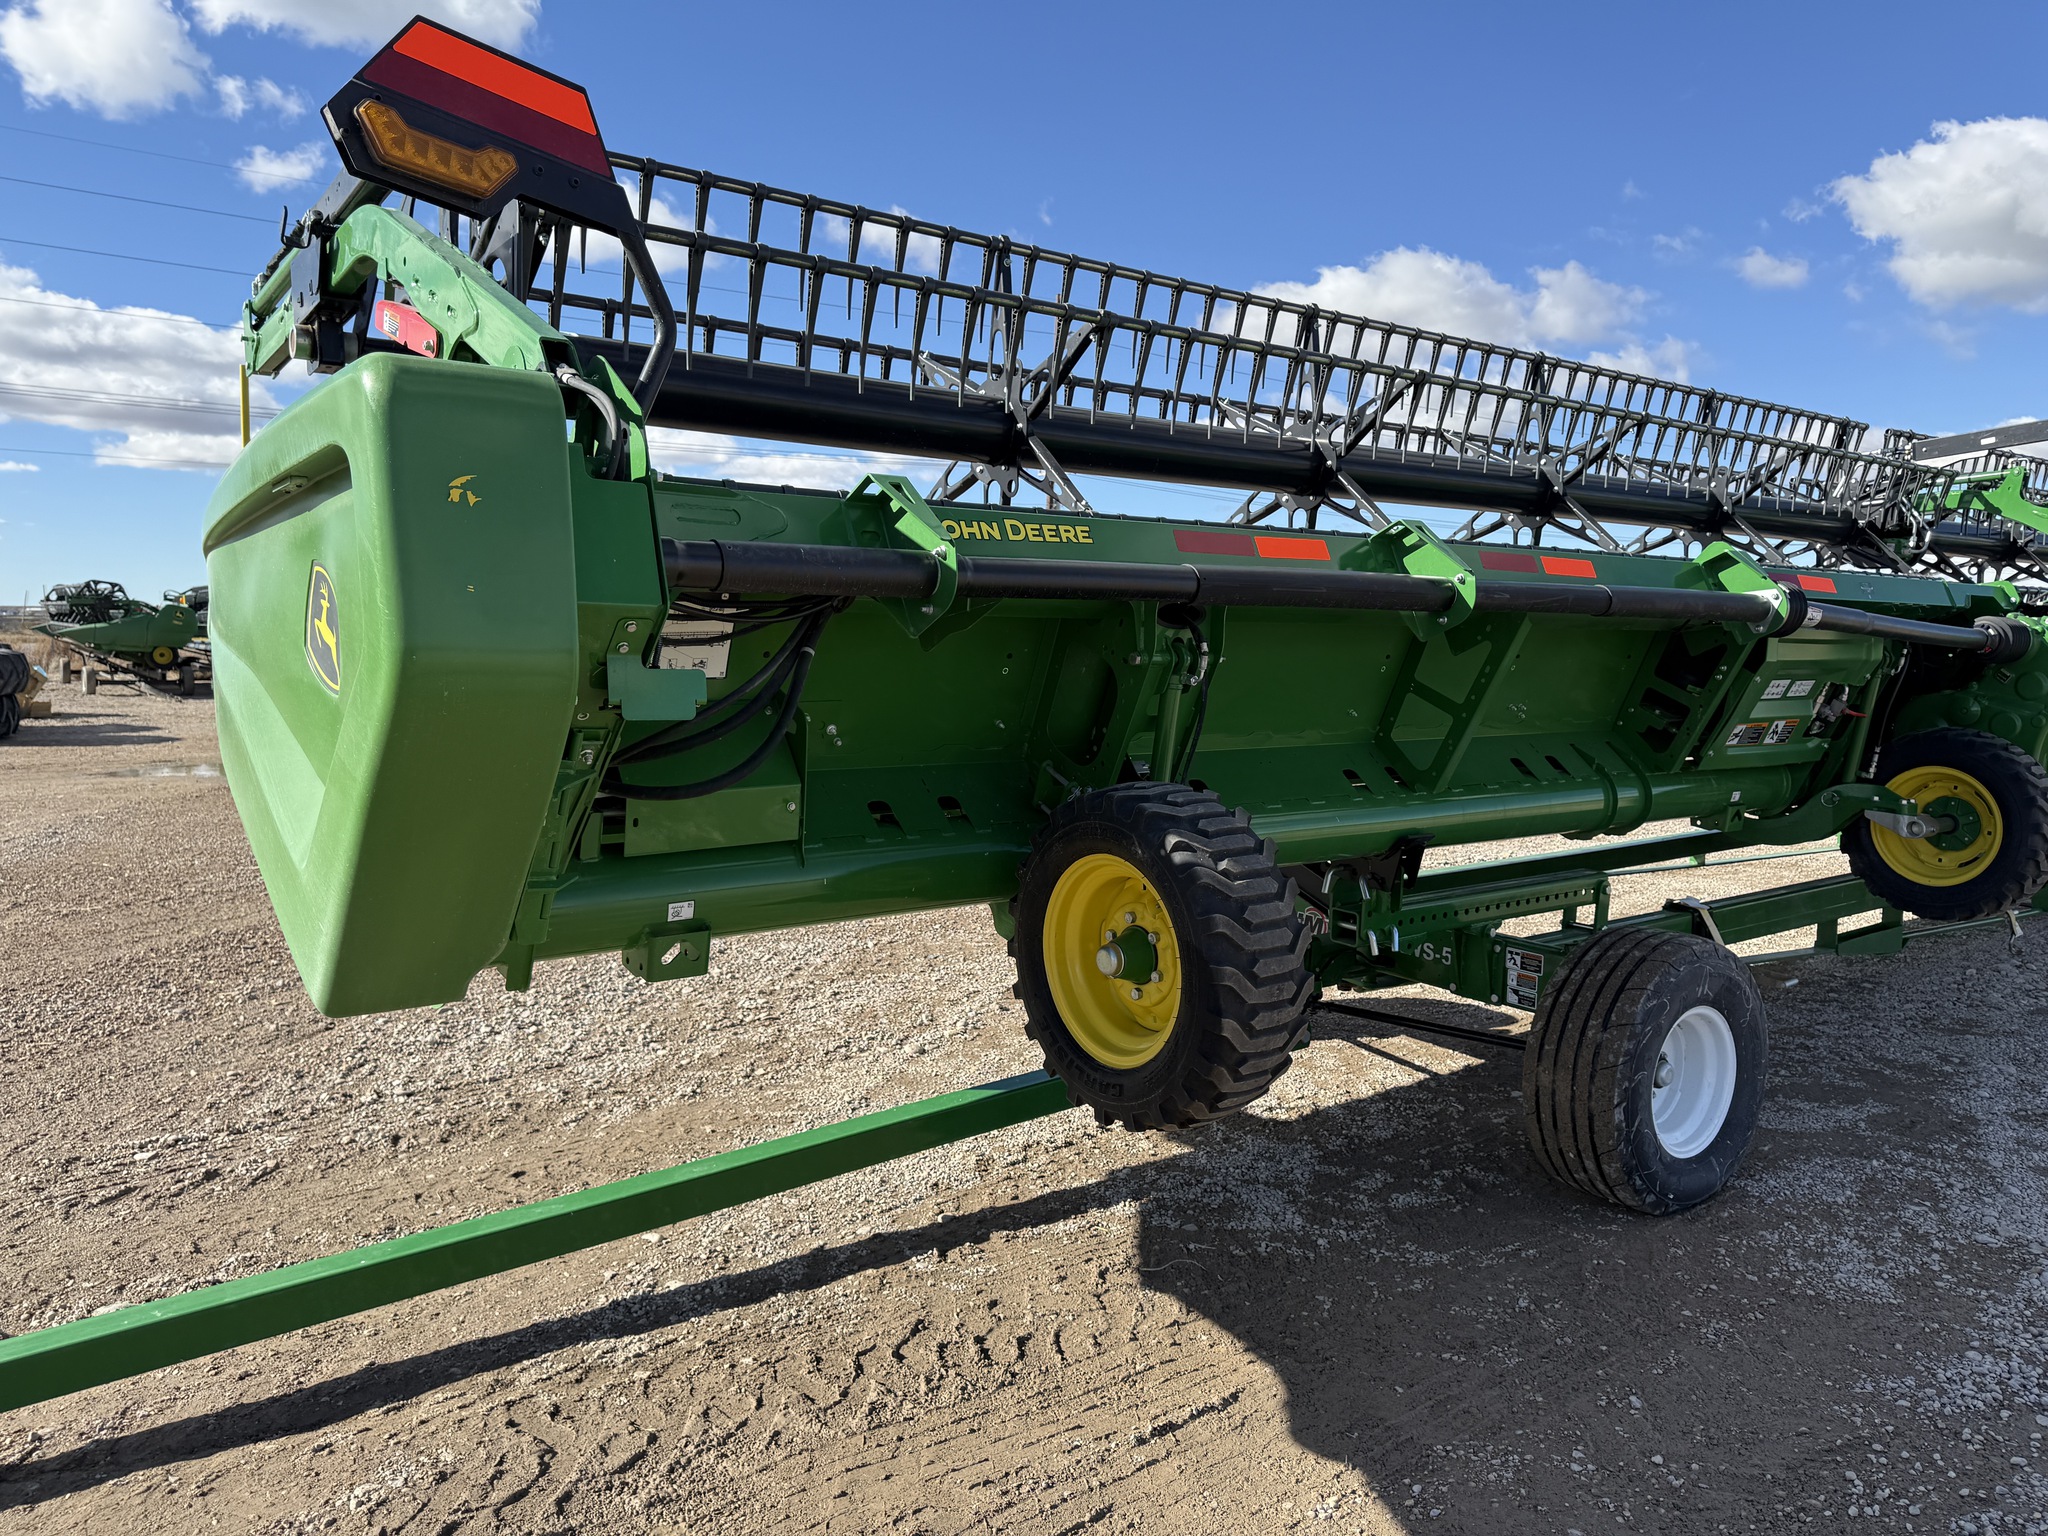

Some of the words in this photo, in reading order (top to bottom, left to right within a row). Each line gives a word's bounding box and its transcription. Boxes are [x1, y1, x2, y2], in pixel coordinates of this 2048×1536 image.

[942, 519, 1001, 541] OHN
[1003, 518, 1094, 544] DEERE
[1038, 1016, 1124, 1097] CARLISLE
